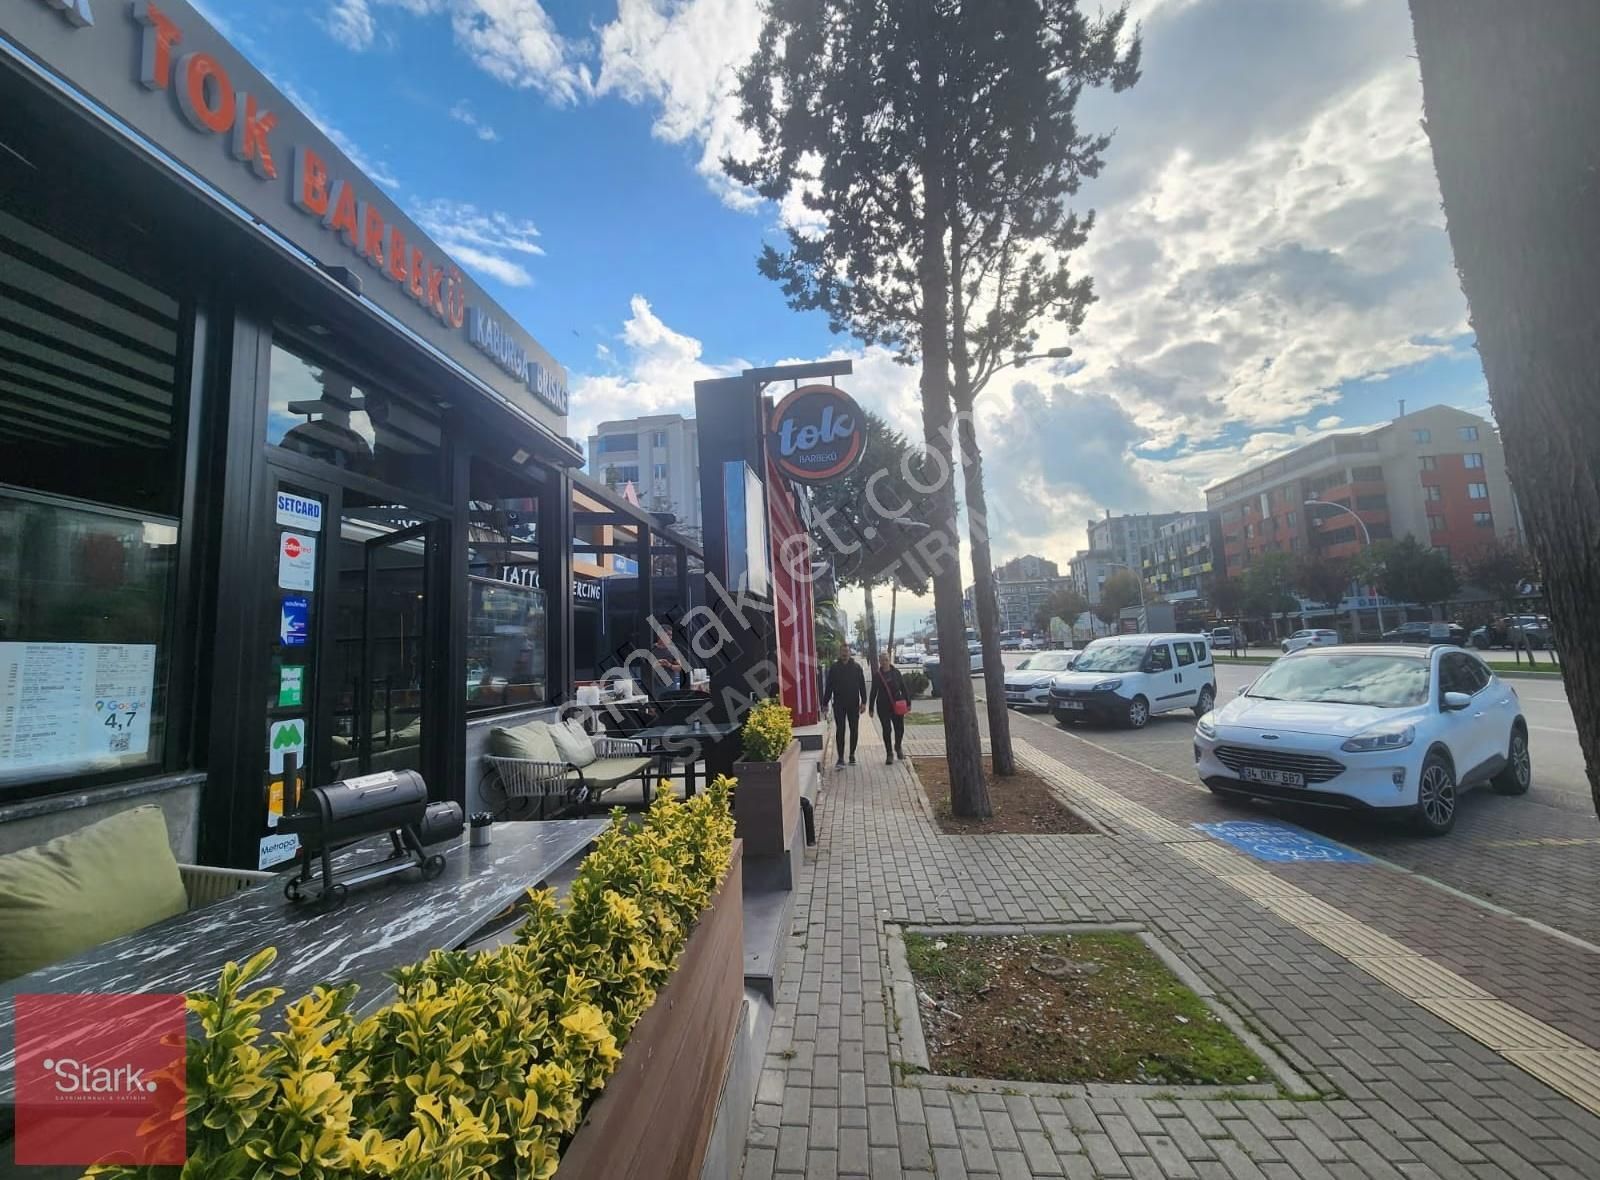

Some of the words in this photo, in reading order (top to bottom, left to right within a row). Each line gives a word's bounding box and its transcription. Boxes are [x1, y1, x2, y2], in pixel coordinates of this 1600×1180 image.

[140, 2, 279, 180] TOK
[297, 147, 464, 329] BARBEKÜ
[476, 306, 529, 382] KABURGA
[778, 405, 856, 456] tok
[278, 495, 320, 518] SETCARD
[104, 711, 138, 731] 4,7
[1246, 768, 1257, 778] 34
